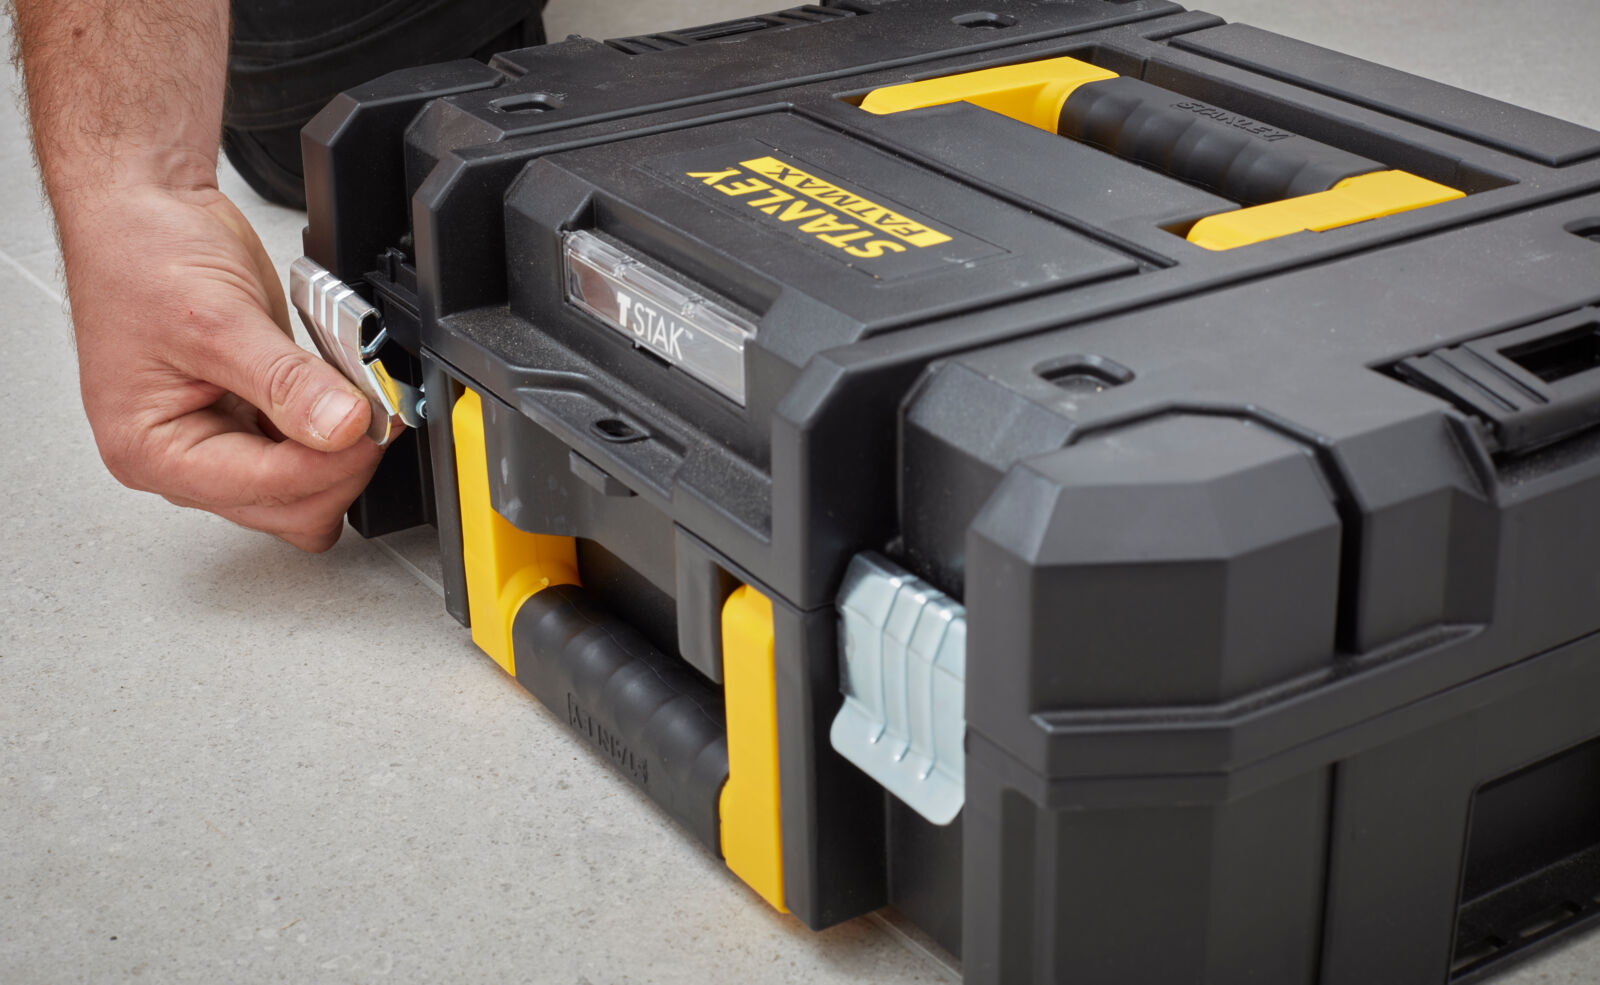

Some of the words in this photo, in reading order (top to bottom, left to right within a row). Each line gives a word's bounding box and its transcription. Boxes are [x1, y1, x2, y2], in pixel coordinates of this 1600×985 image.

[1172, 101, 1292, 142] STANLEY
[686, 168, 907, 258] STANLEY
[765, 165, 927, 238] FATMAX
